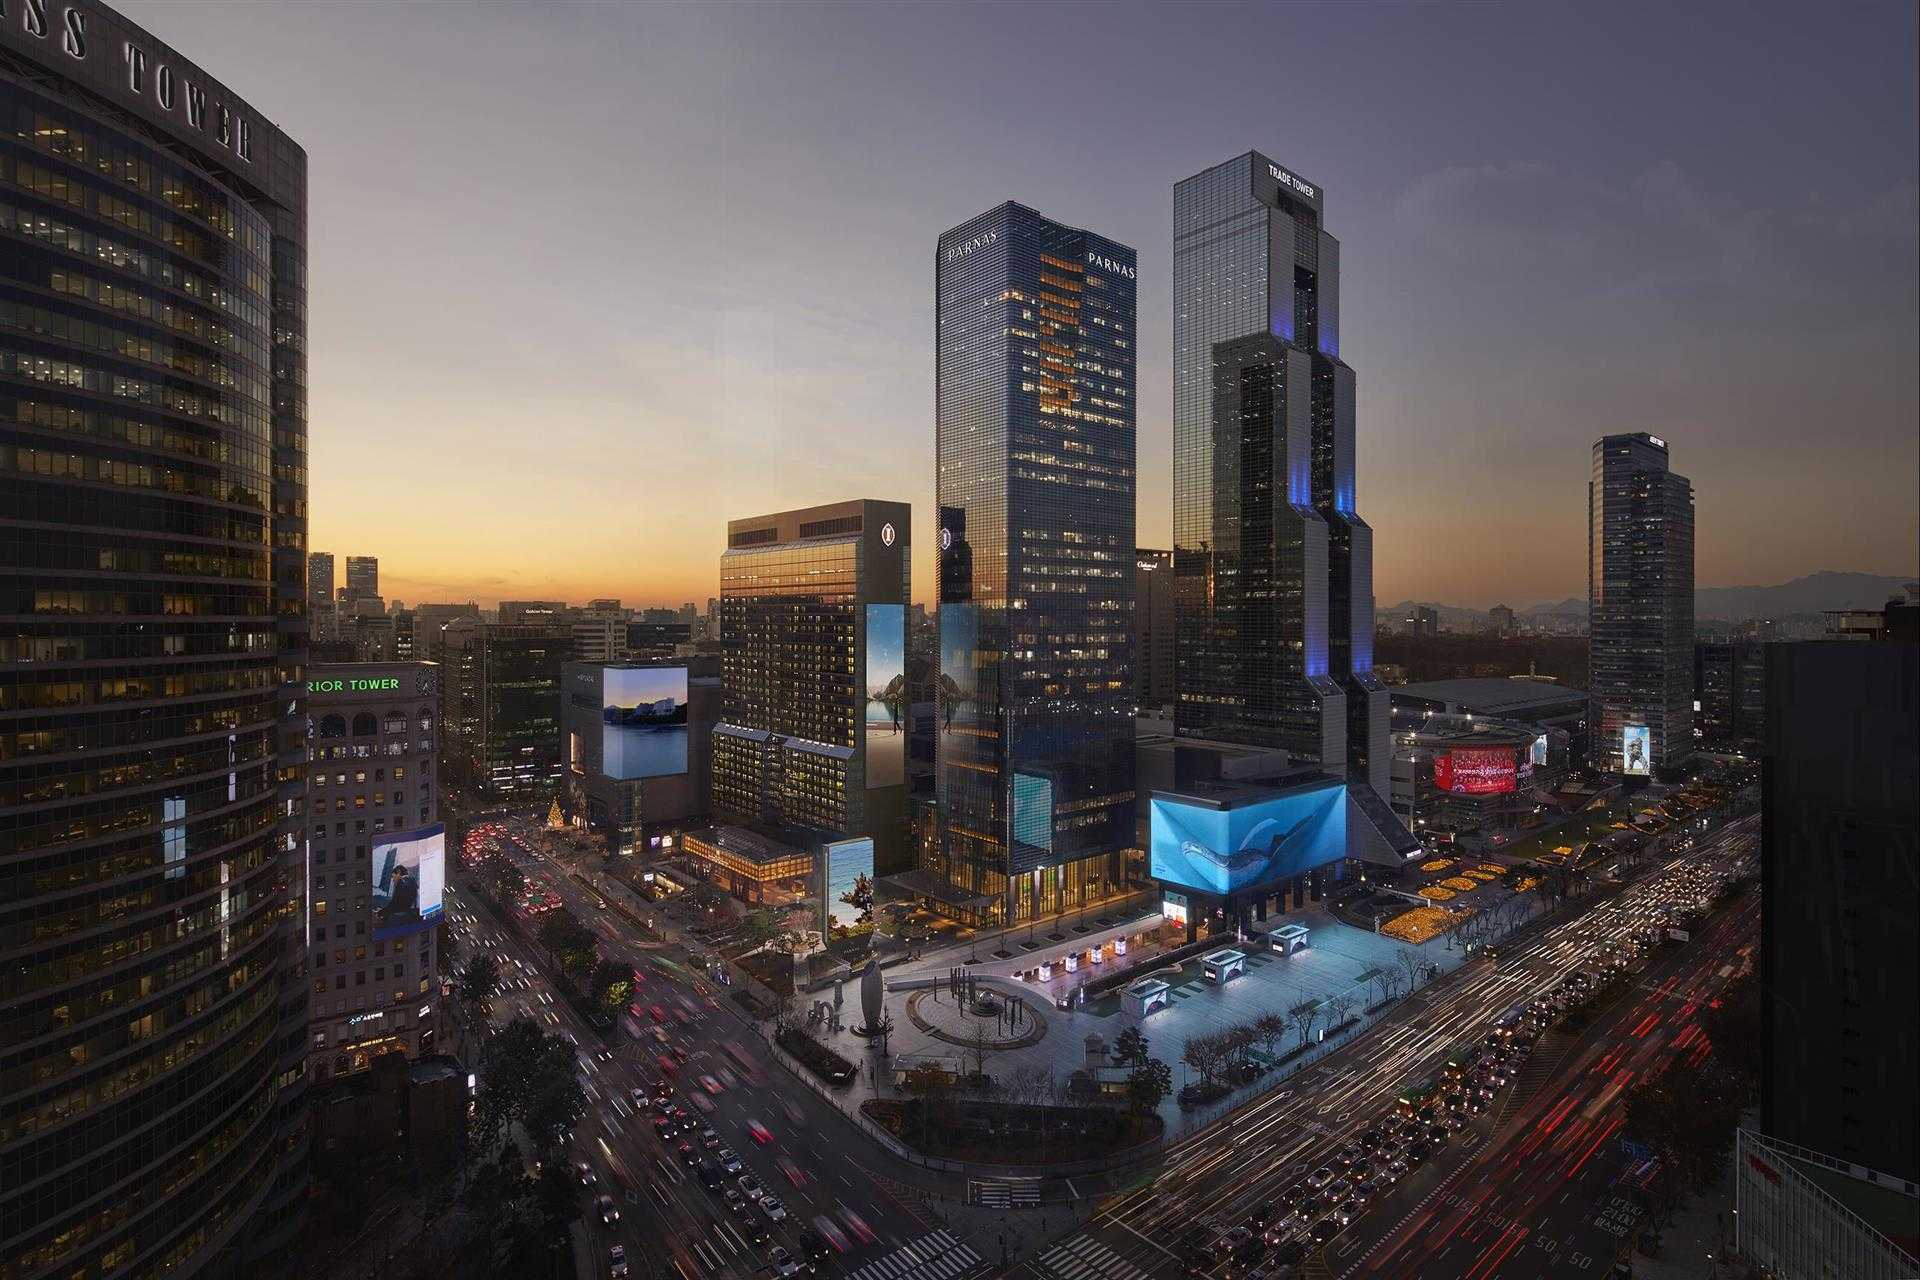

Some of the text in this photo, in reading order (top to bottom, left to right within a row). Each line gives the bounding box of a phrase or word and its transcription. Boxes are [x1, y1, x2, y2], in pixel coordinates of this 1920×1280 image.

[0, 0, 252, 163] SS TOWER
[1268, 164, 1314, 198] TRADE TOWER
[947, 231, 998, 262] PARNAS
[1088, 252, 1136, 279] PARNAS
[350, 678, 399, 690] TOWER
[1536, 1235, 1558, 1253] 50
[1568, 1251, 1592, 1270] 50
